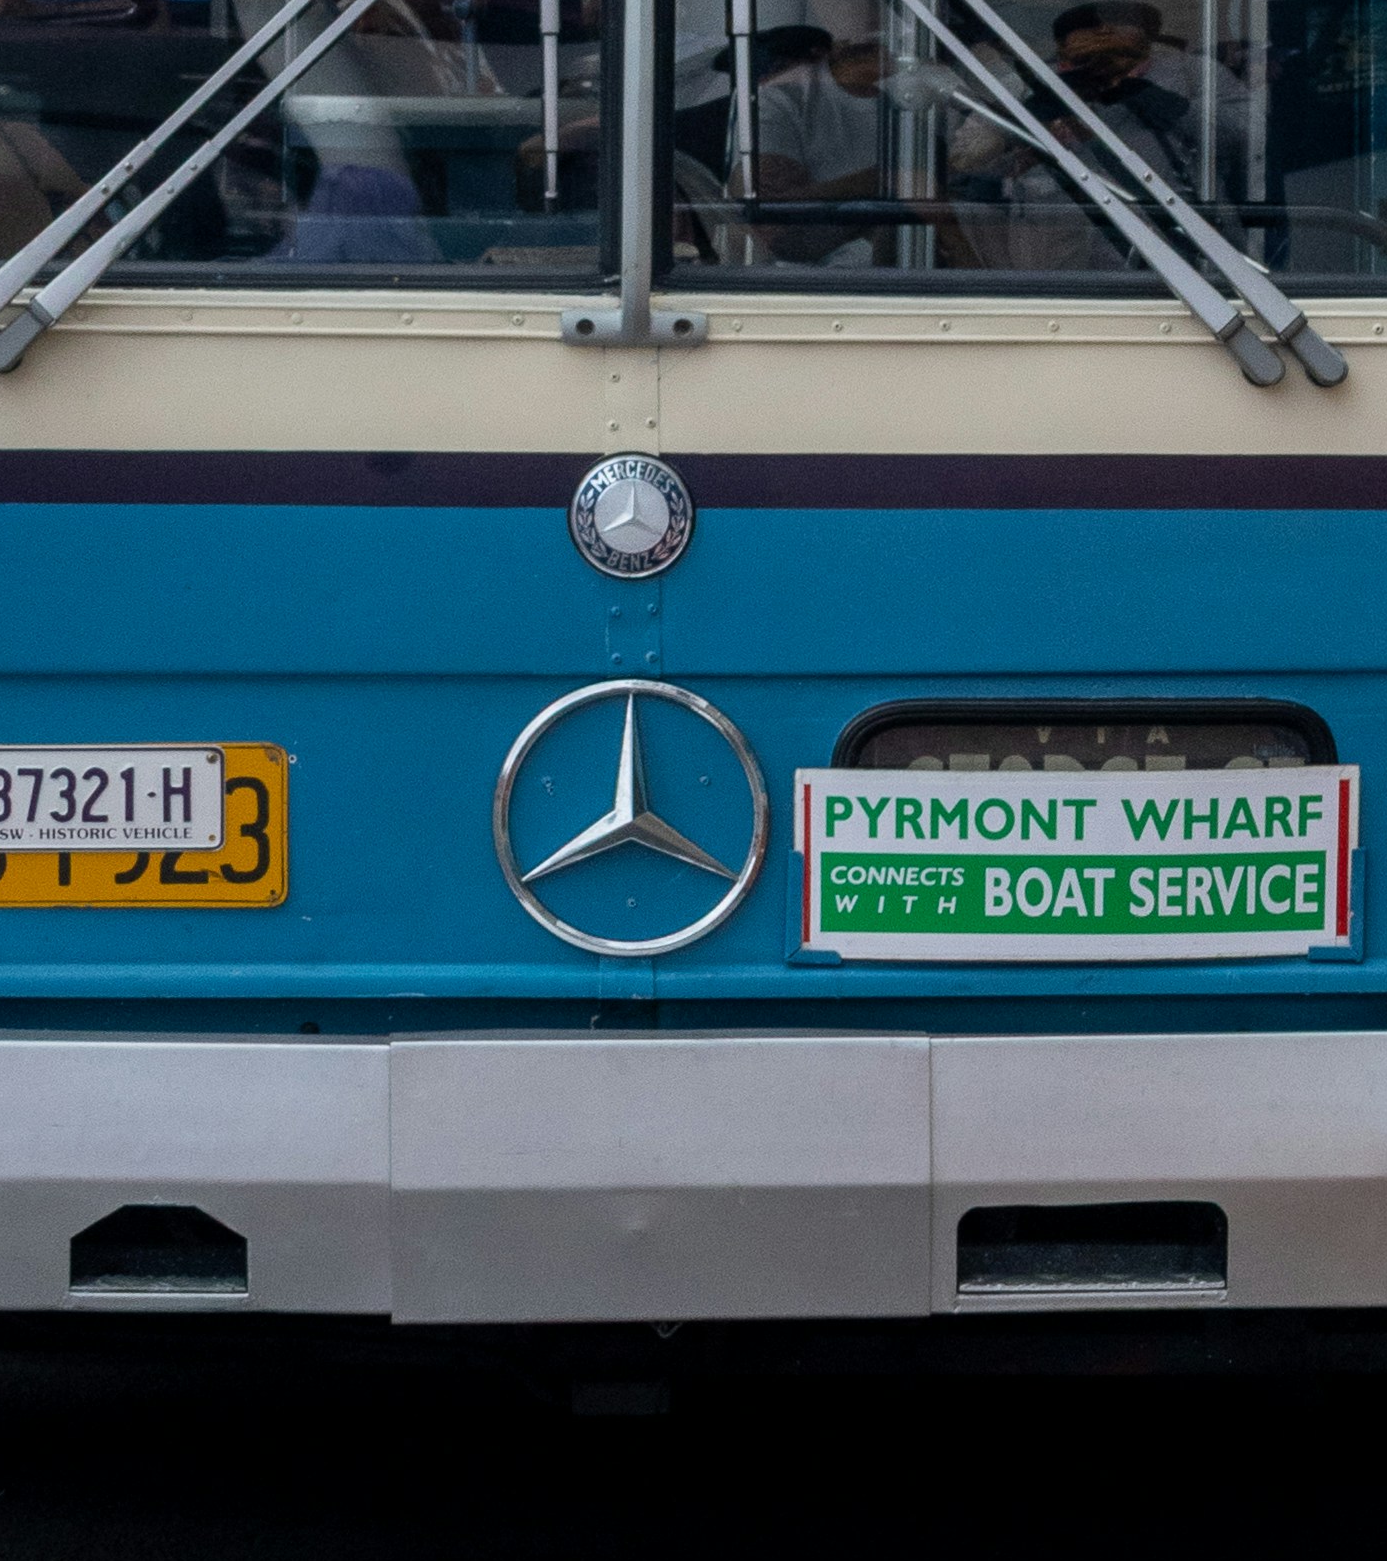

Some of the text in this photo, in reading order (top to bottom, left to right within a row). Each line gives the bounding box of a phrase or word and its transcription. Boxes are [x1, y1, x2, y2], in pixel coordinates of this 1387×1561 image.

[590, 460, 675, 493] MERCEDES
[606, 552, 653, 571] BENZ
[825, 794, 1323, 841] PYRMONT WHARF
[39, 828, 117, 840] HISTORIC
[122, 827, 193, 839] VEHICLE
[830, 865, 965, 892] CONNECTS
[984, 863, 1320, 918] BOAT SERVICE
[835, 894, 958, 915] WITH
